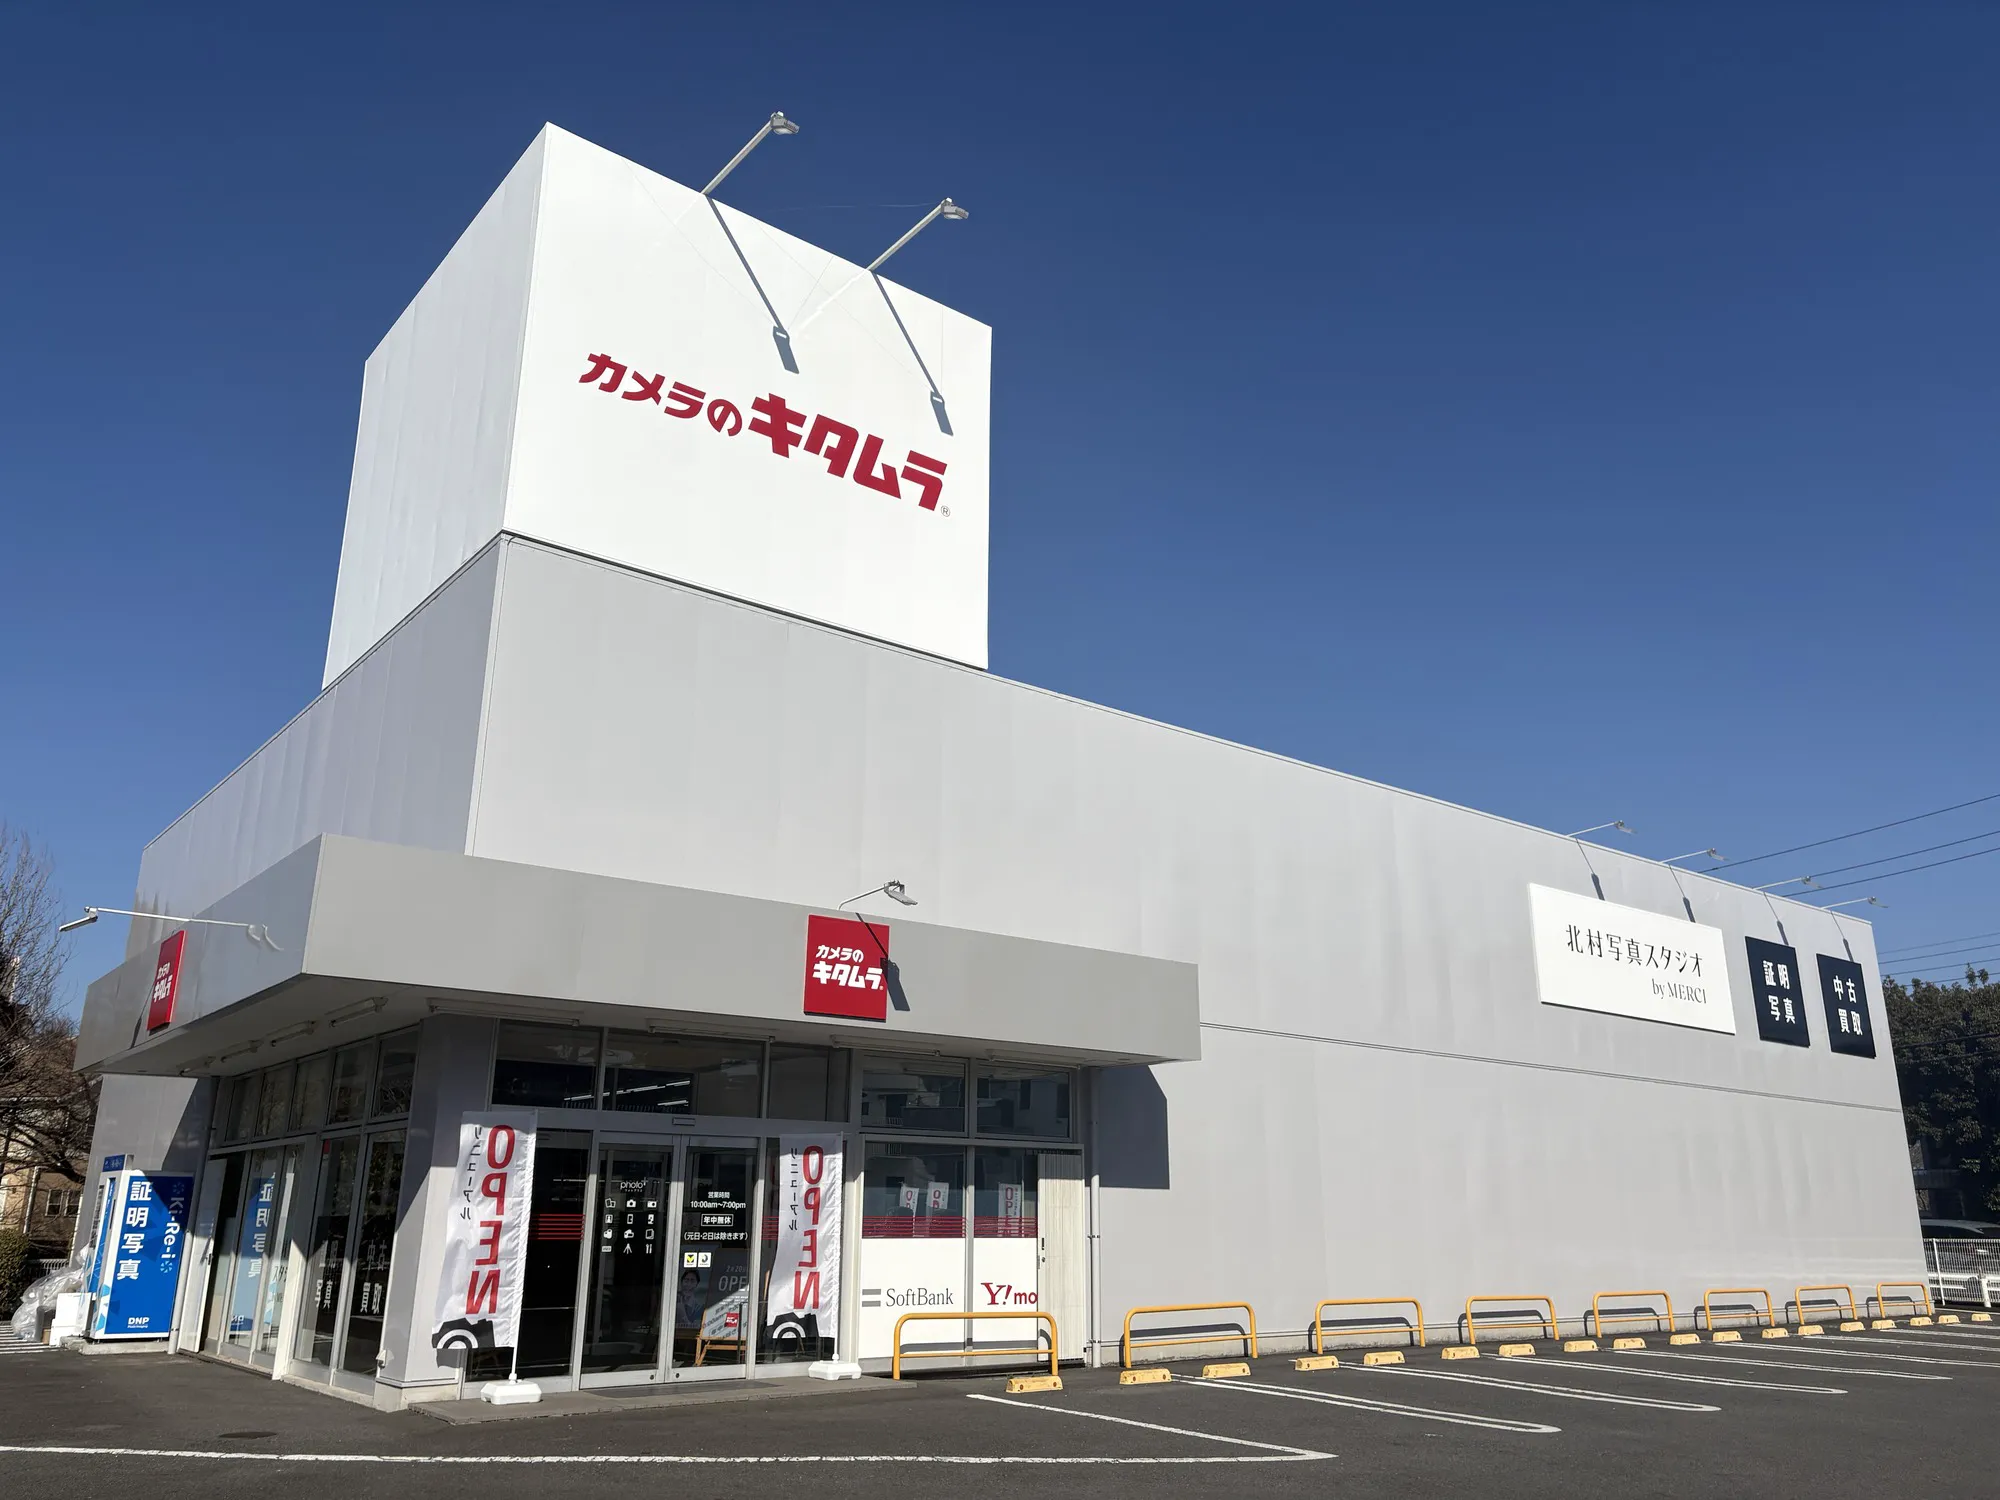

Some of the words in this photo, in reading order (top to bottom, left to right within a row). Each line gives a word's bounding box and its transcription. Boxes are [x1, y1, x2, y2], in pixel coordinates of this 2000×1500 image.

[815, 944, 865, 963] カメラの
[1566, 925, 1702, 977] 北村写真スタジオ
[812, 961, 883, 990] キタムラ
[1652, 978, 1665, 999] by
[1668, 982, 1707, 1004] MERCI
[116, 1181, 152, 1281] 証明写真
[886, 1287, 954, 1307] SoftBank
[128, 1316, 150, 1325] DNP
